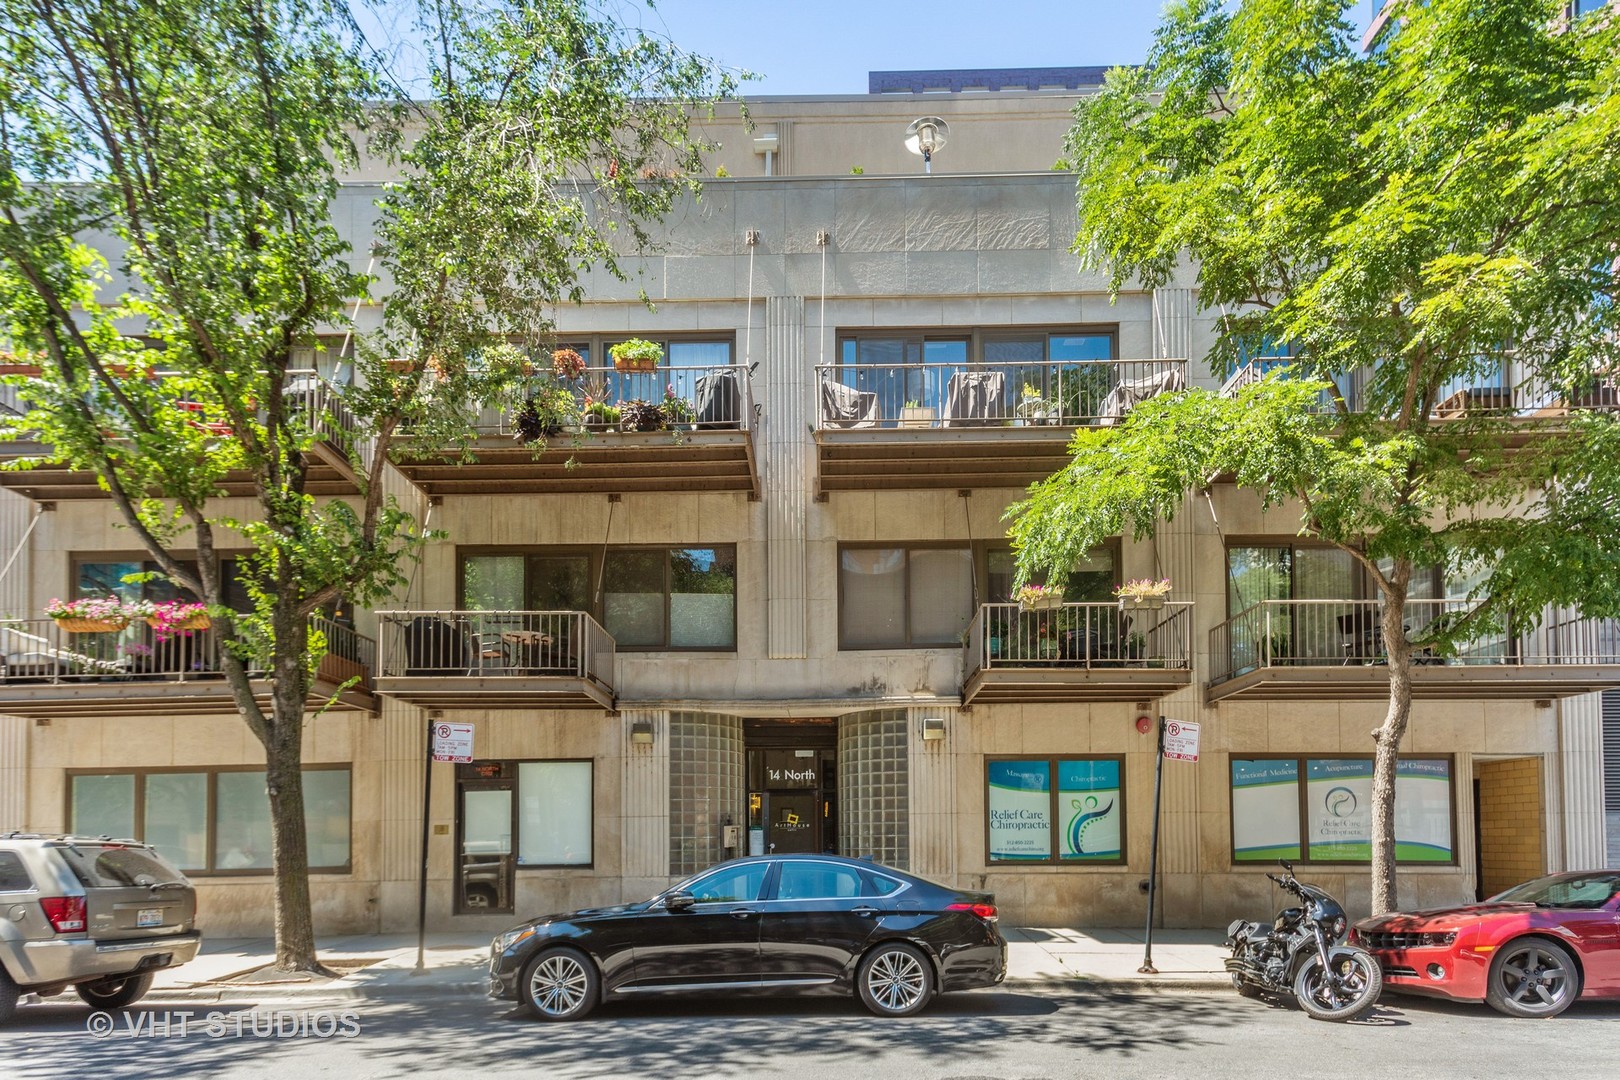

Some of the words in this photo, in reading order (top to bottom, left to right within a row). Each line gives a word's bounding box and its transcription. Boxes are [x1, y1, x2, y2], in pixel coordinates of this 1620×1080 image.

[1325, 764, 1363, 773] Acupuncture
[1408, 762, 1445, 772] Chiropractic
[769, 769, 780, 780] 14
[784, 769, 815, 780] North
[1235, 770, 1268, 780] Functional
[1269, 768, 1298, 777] Medicine
[990, 809, 1019, 820] Relief
[1020, 809, 1043, 820] Care
[990, 820, 1050, 831] Chiropractic
[1320, 828, 1363, 836] Chiropractic
